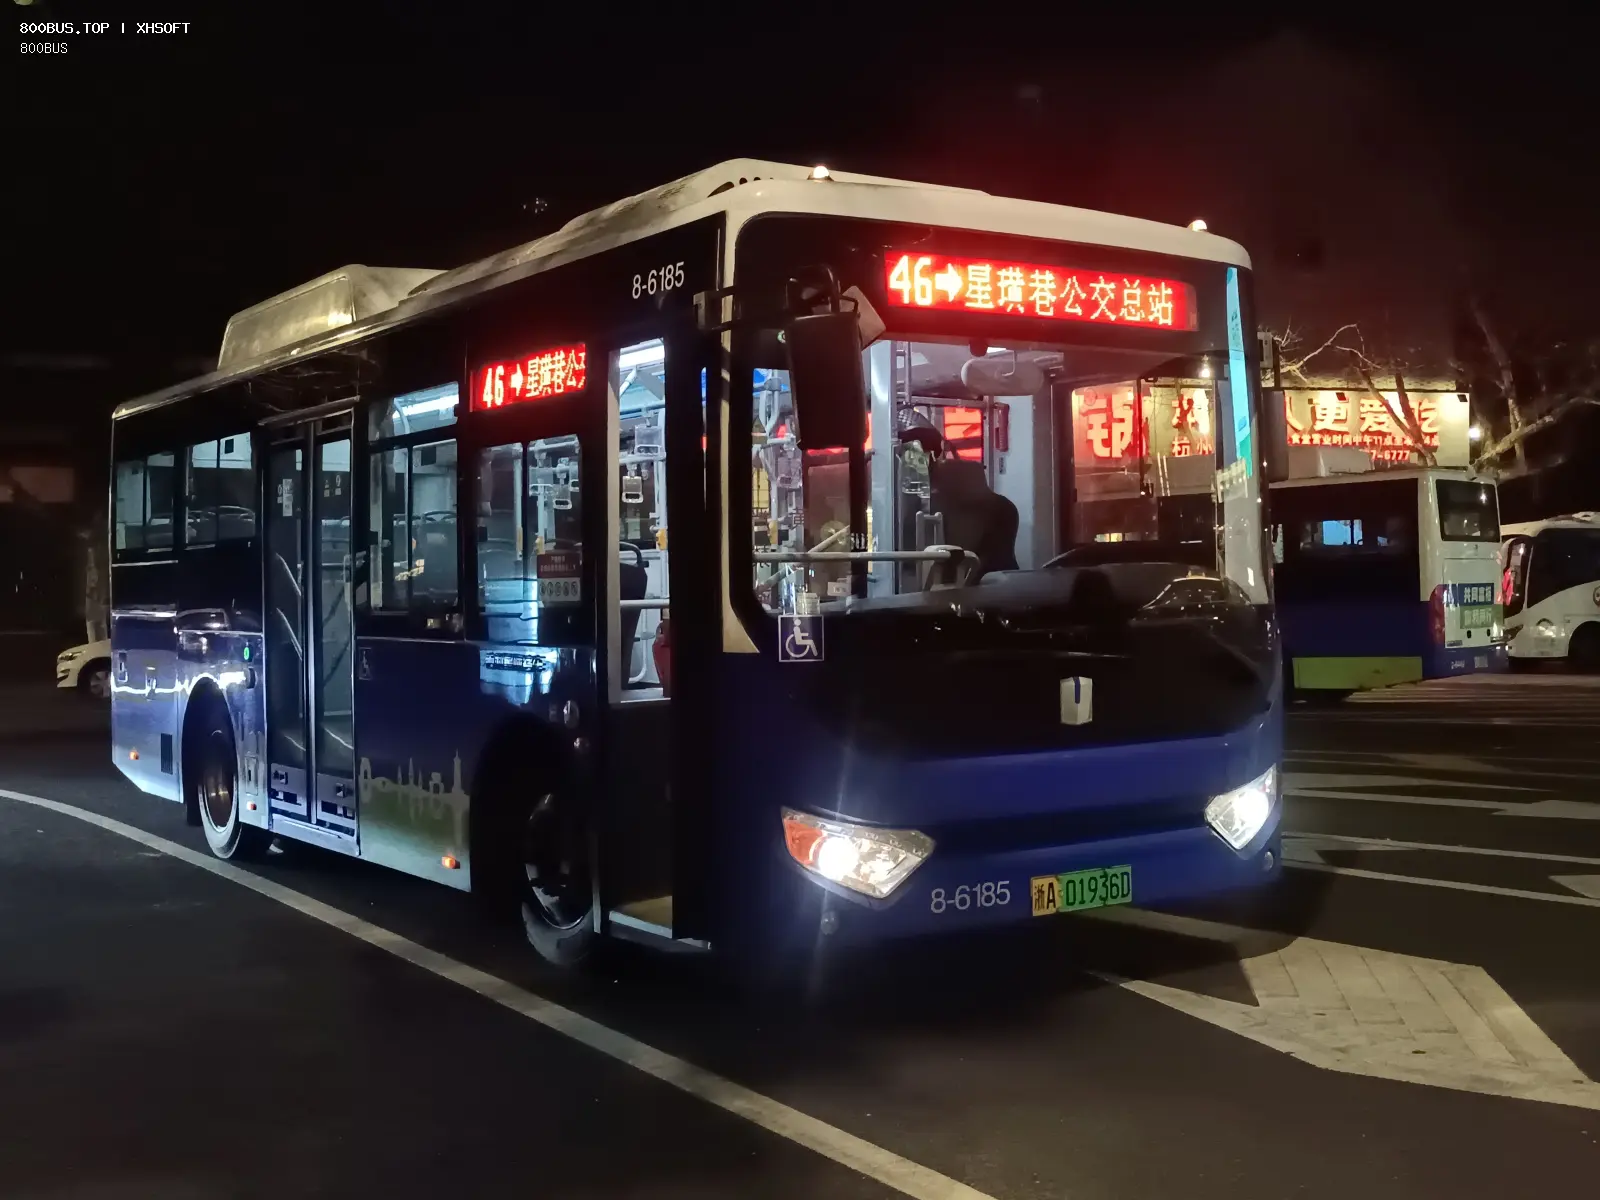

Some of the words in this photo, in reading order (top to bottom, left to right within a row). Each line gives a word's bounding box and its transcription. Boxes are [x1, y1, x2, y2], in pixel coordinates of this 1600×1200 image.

[631, 261, 685, 300] 8-6185
[889, 255, 933, 306] 46
[483, 365, 504, 408] 46
[930, 880, 1011, 914] 8-6185
